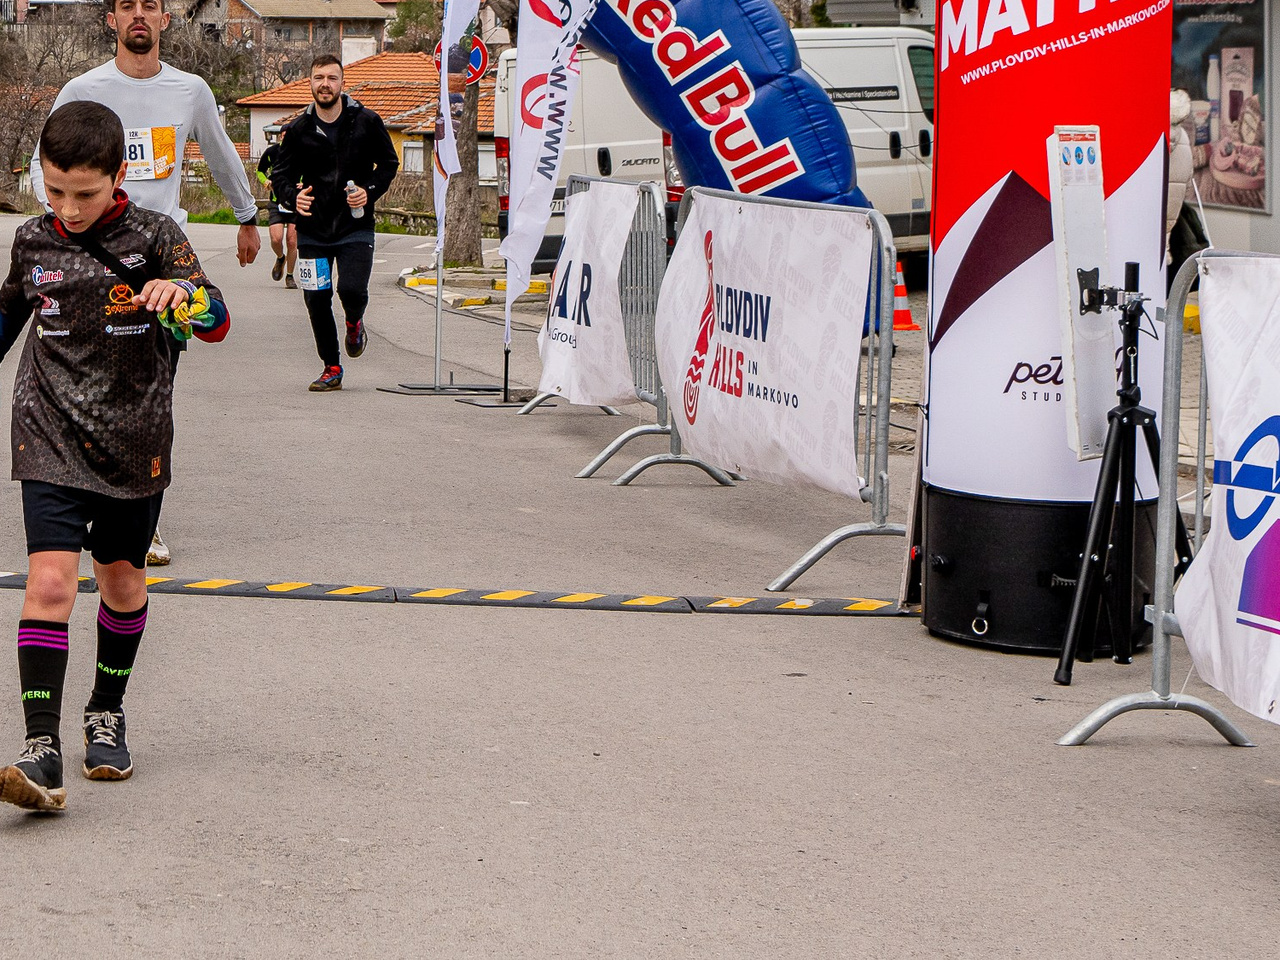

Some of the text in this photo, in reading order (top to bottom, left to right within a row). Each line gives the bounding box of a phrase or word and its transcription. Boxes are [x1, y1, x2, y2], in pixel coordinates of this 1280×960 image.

[686, 66, 799, 195] Bull
[715, 283, 771, 343] PLOVDIV
[748, 359, 758, 376] IN
[747, 381, 799, 409] MARKOVO
[1021, 390, 1062, 402] STUD
